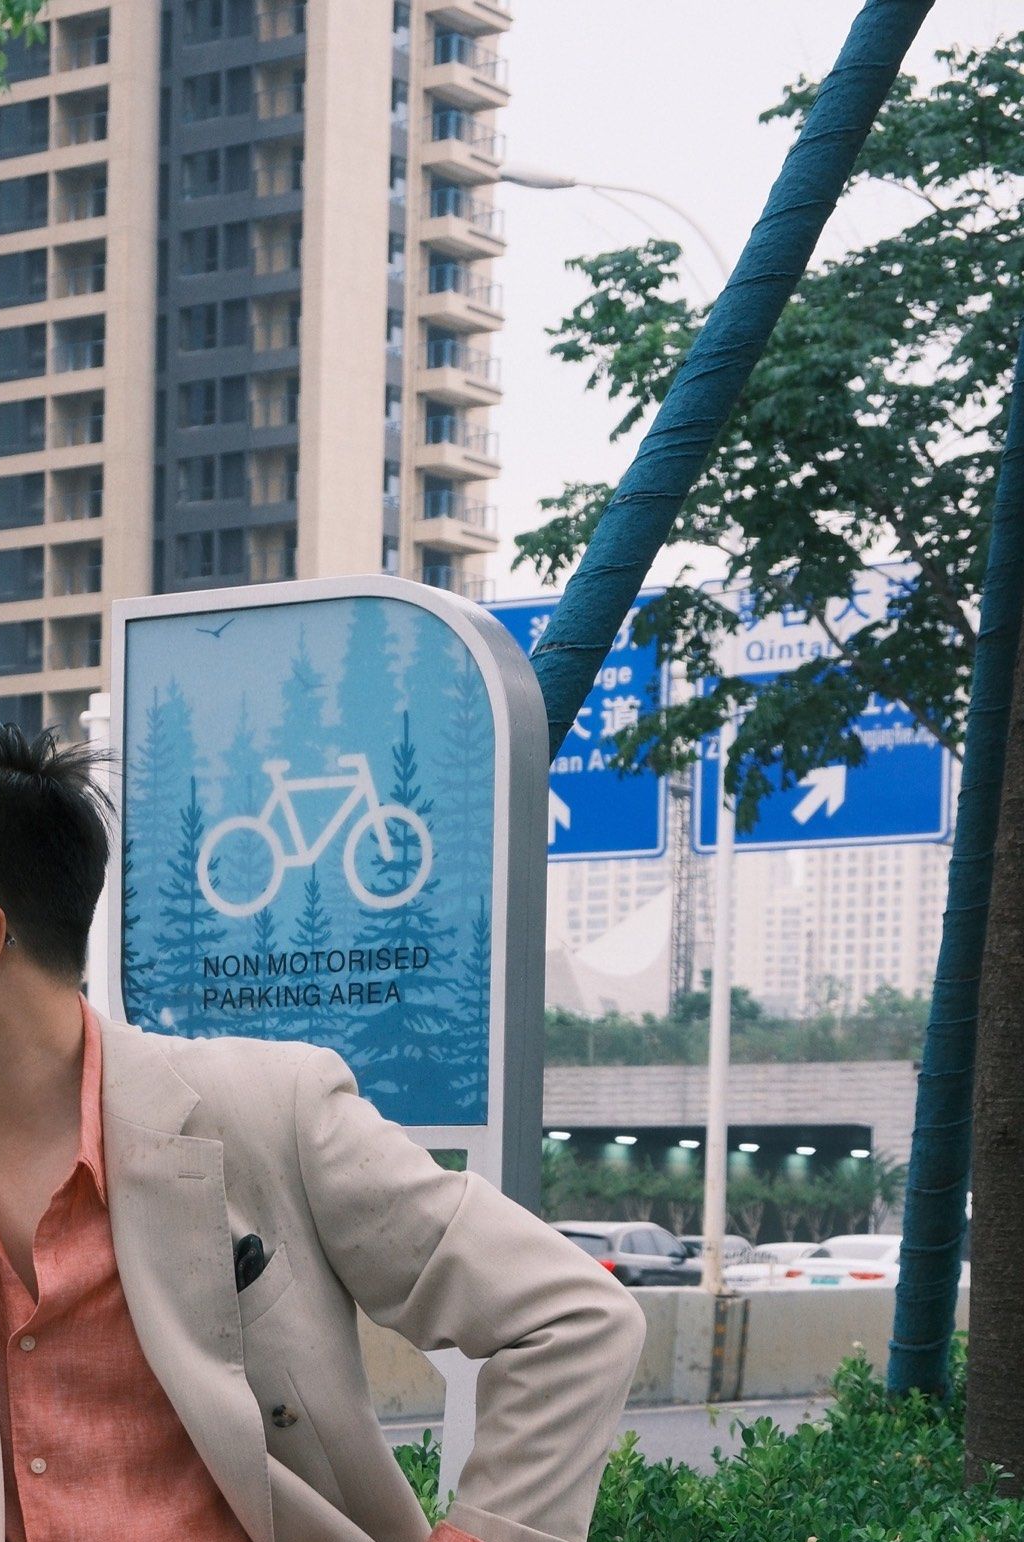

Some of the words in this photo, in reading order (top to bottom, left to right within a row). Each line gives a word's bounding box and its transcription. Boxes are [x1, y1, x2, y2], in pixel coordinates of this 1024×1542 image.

[203, 954, 260, 978] NON
[267, 946, 430, 976] MOTORISED
[203, 983, 322, 1010] PARKING
[328, 981, 401, 1006] AREA
